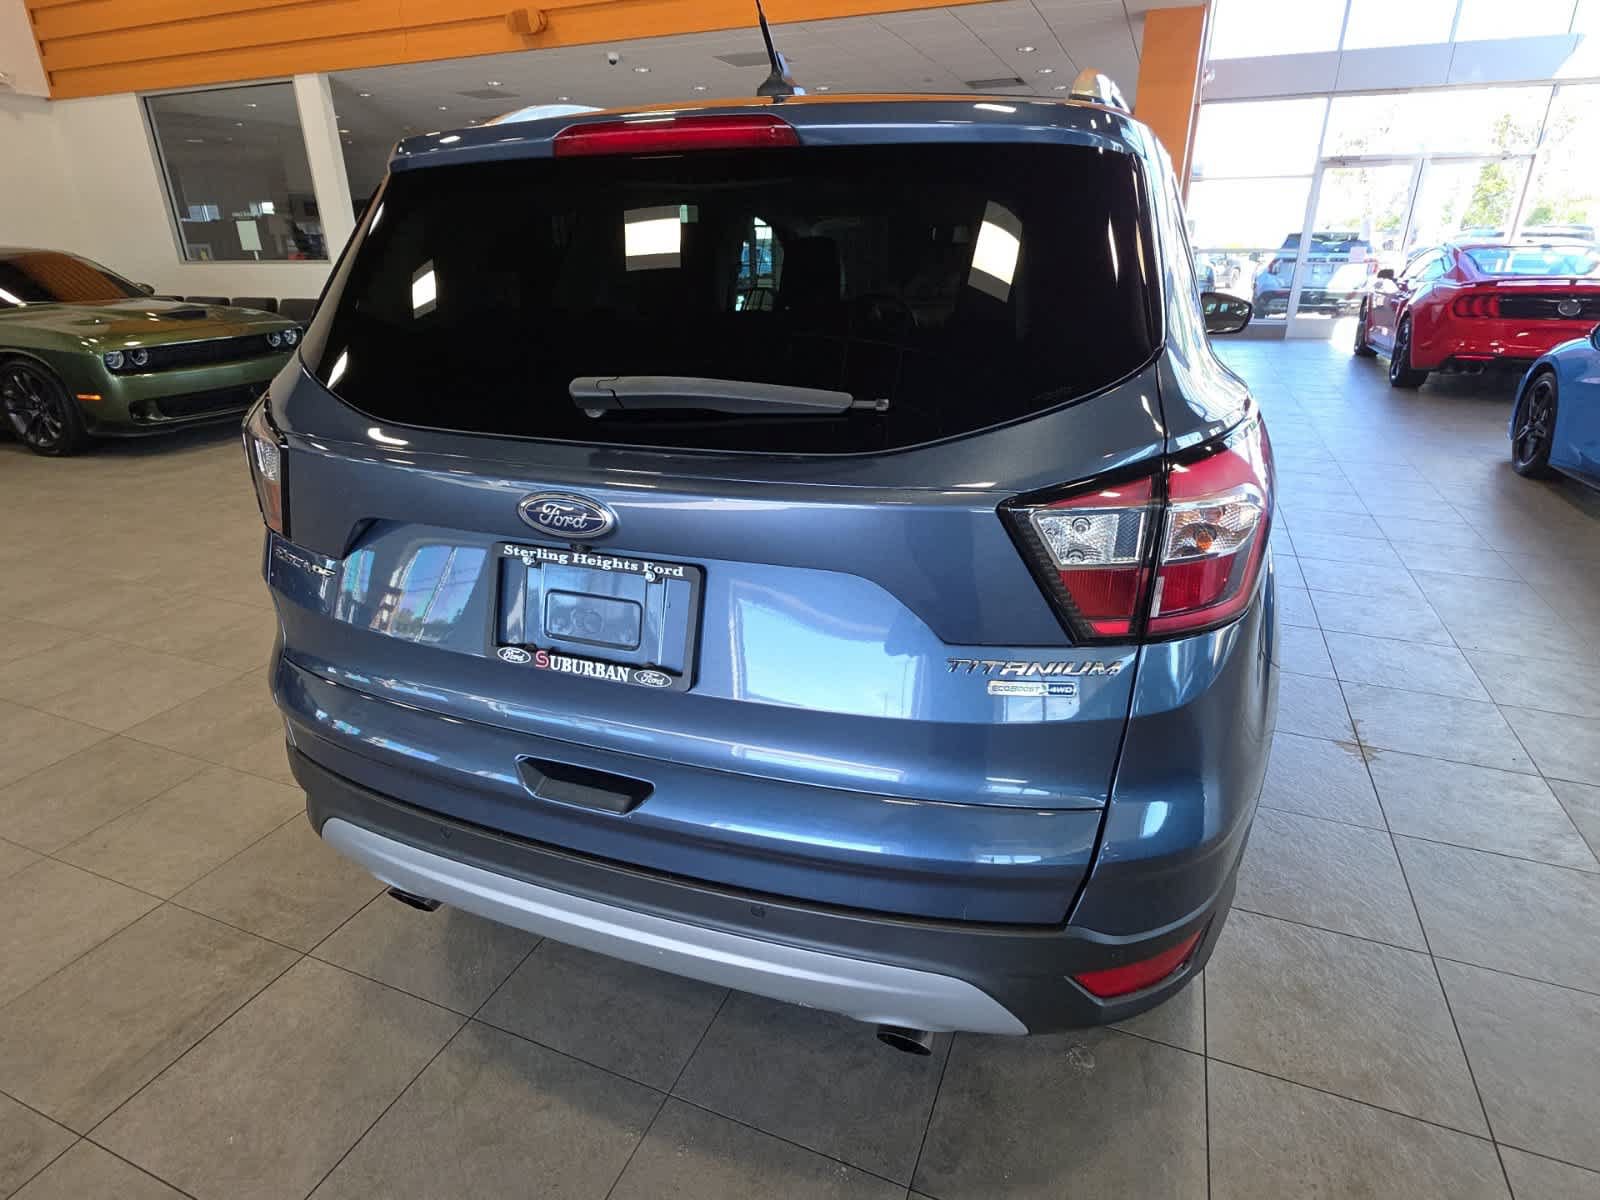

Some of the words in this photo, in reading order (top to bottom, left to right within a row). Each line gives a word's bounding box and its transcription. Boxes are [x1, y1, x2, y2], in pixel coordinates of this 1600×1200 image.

[537, 503, 588, 530] Ford
[503, 544, 569, 564] Sterling
[572, 553, 639, 572] Heights
[643, 562, 684, 577] Ford
[503, 649, 526, 663] Ford
[534, 650, 630, 683] SUBURBAN
[640, 673, 665, 687] Ford
[948, 658, 1121, 677] TITANIUM
[1049, 686, 1073, 695] 4WD
